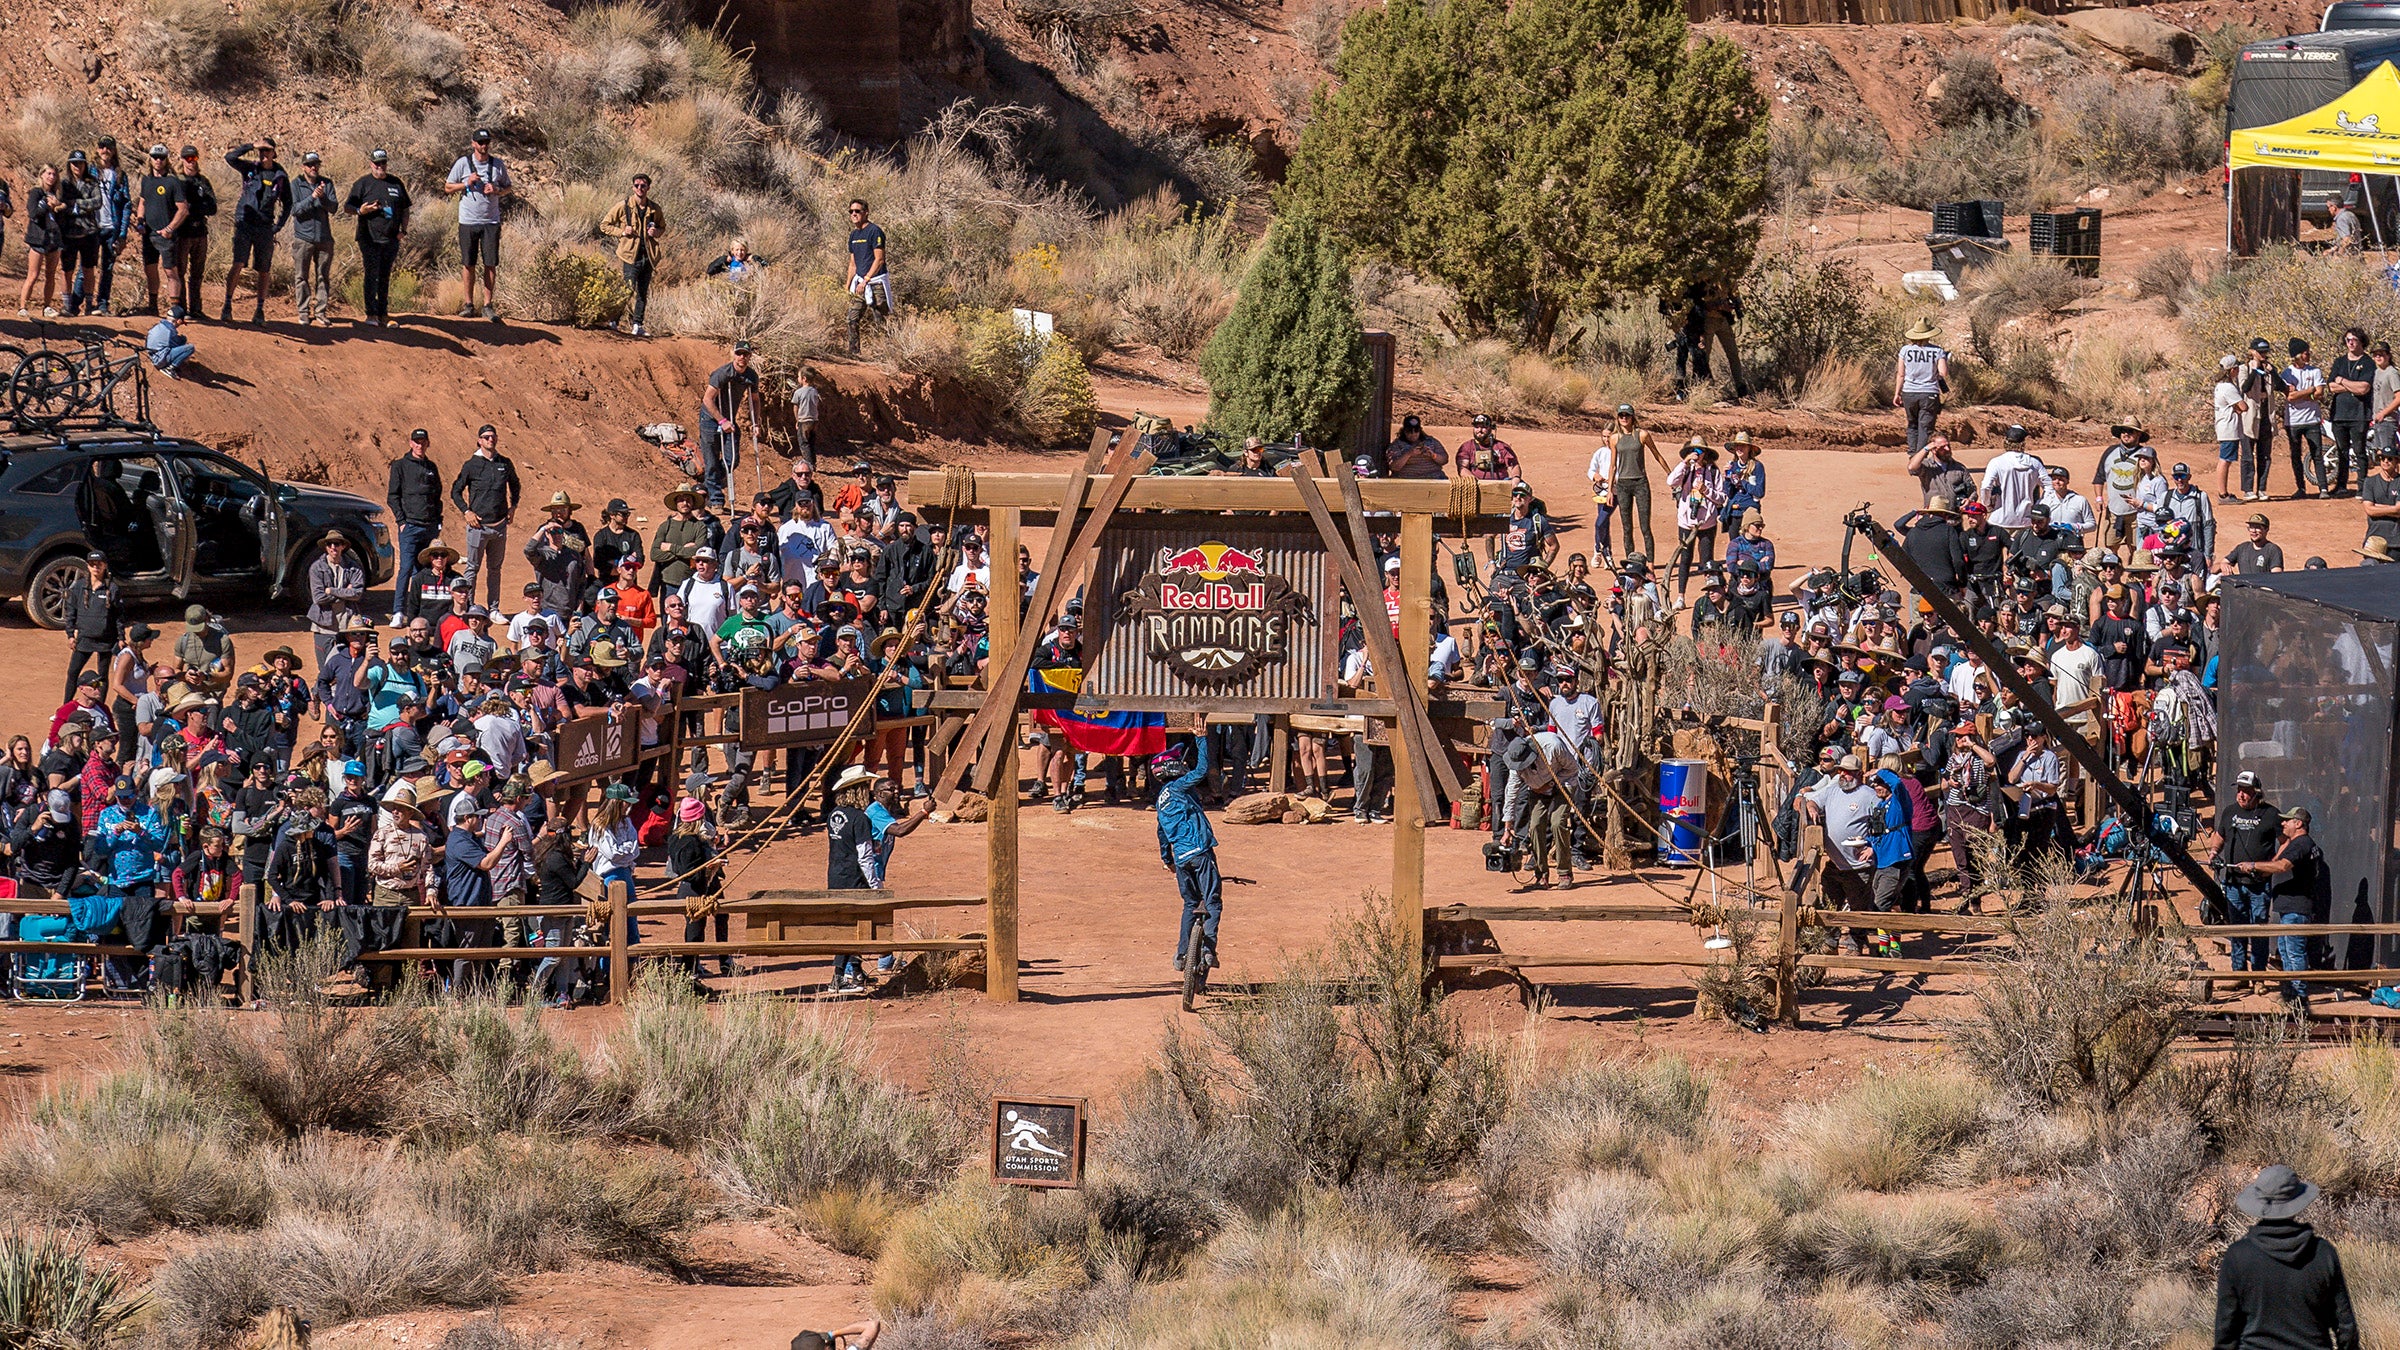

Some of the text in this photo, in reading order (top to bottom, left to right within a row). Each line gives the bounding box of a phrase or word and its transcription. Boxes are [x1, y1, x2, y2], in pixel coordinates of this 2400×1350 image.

[2302, 51, 2340, 61] TERREX
[2306, 129, 2400, 139] MICHELIN
[2271, 146, 2320, 156] MICHELIN
[1906, 350, 1938, 363] STAFF
[1161, 583, 1264, 610] Red Bull
[1147, 616, 1279, 652] RAMPAGE
[767, 695, 848, 715] GoPro
[574, 754, 599, 768] adidas
[1659, 794, 1699, 807] Red Bull
[1005, 1155, 1059, 1165] UTAH SPORTS
[1005, 1163, 1059, 1172] COMMISSION
